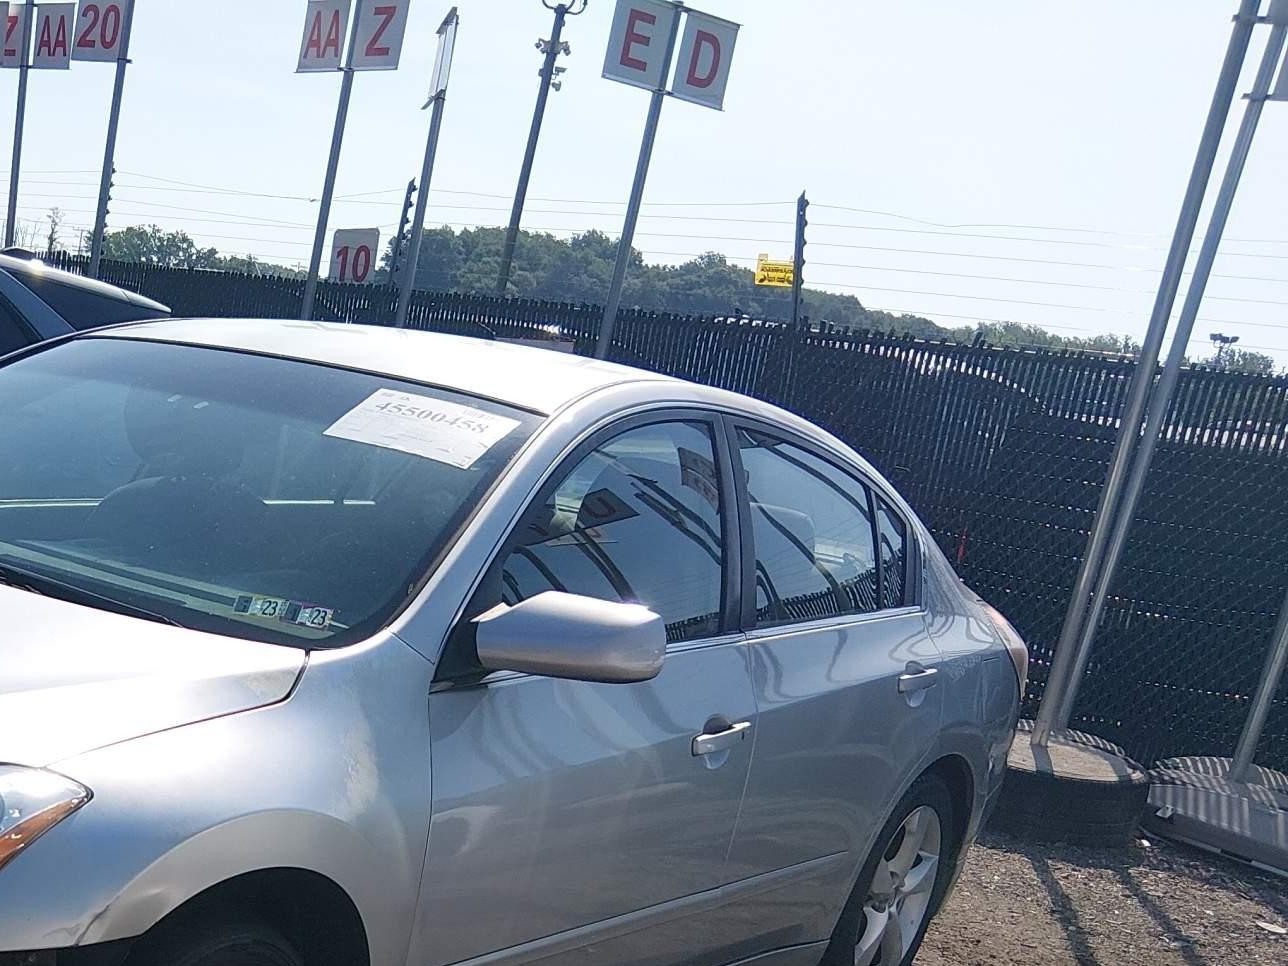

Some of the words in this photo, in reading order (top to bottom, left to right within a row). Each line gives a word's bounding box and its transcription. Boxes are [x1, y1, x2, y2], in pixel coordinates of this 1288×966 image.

[37, 14, 67, 57] AA
[77, 4, 120, 49] 20
[303, 9, 340, 58] AA
[365, 6, 397, 56] Z
[619, 8, 657, 72] E
[686, 29, 721, 88] D
[337, 245, 371, 282] 10
